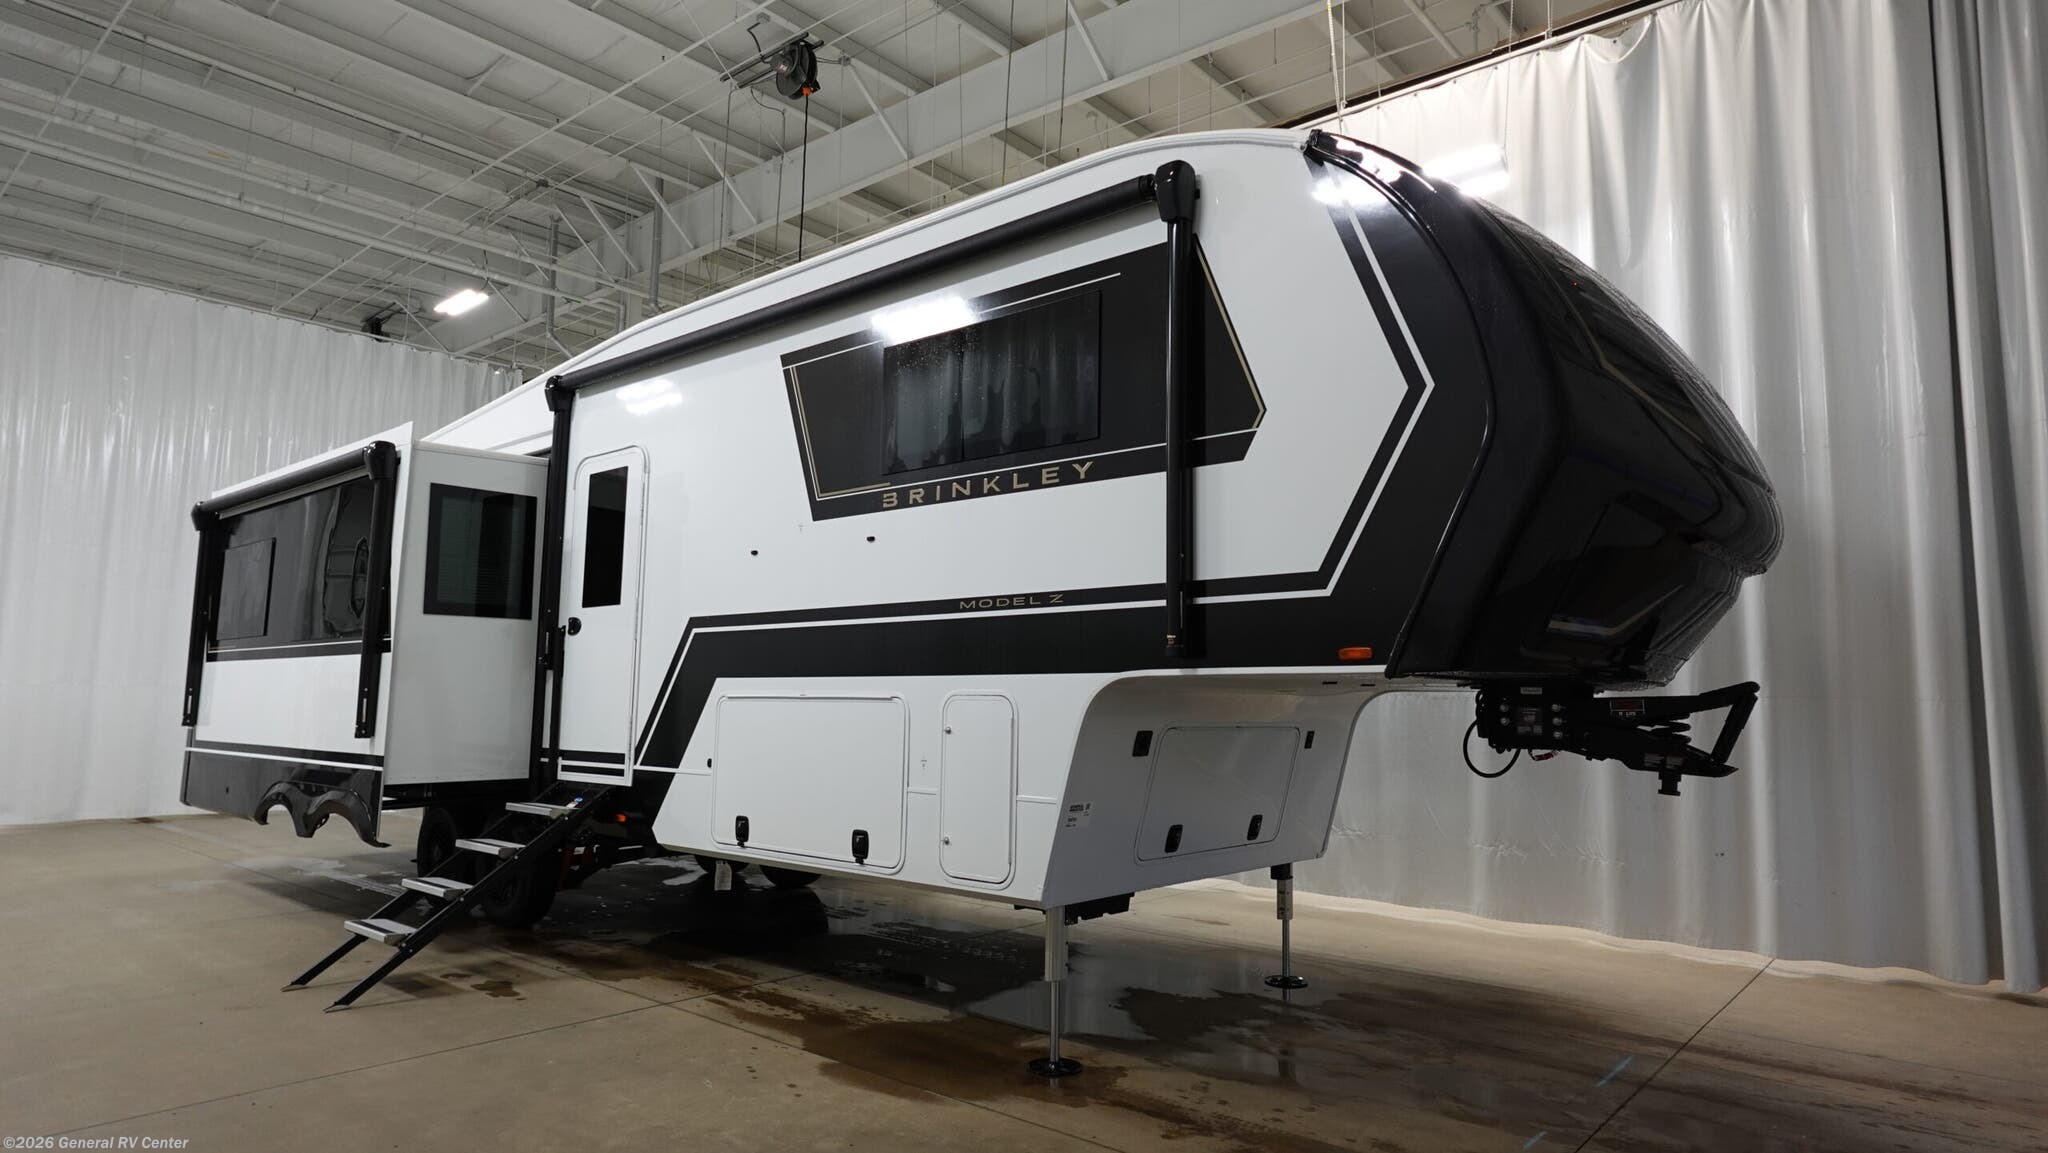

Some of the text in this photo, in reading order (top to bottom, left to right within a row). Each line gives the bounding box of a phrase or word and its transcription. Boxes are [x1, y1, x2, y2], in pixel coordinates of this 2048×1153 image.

[882, 461, 1093, 508] BRINKLEY
[959, 593, 1064, 609] MODEL Z
